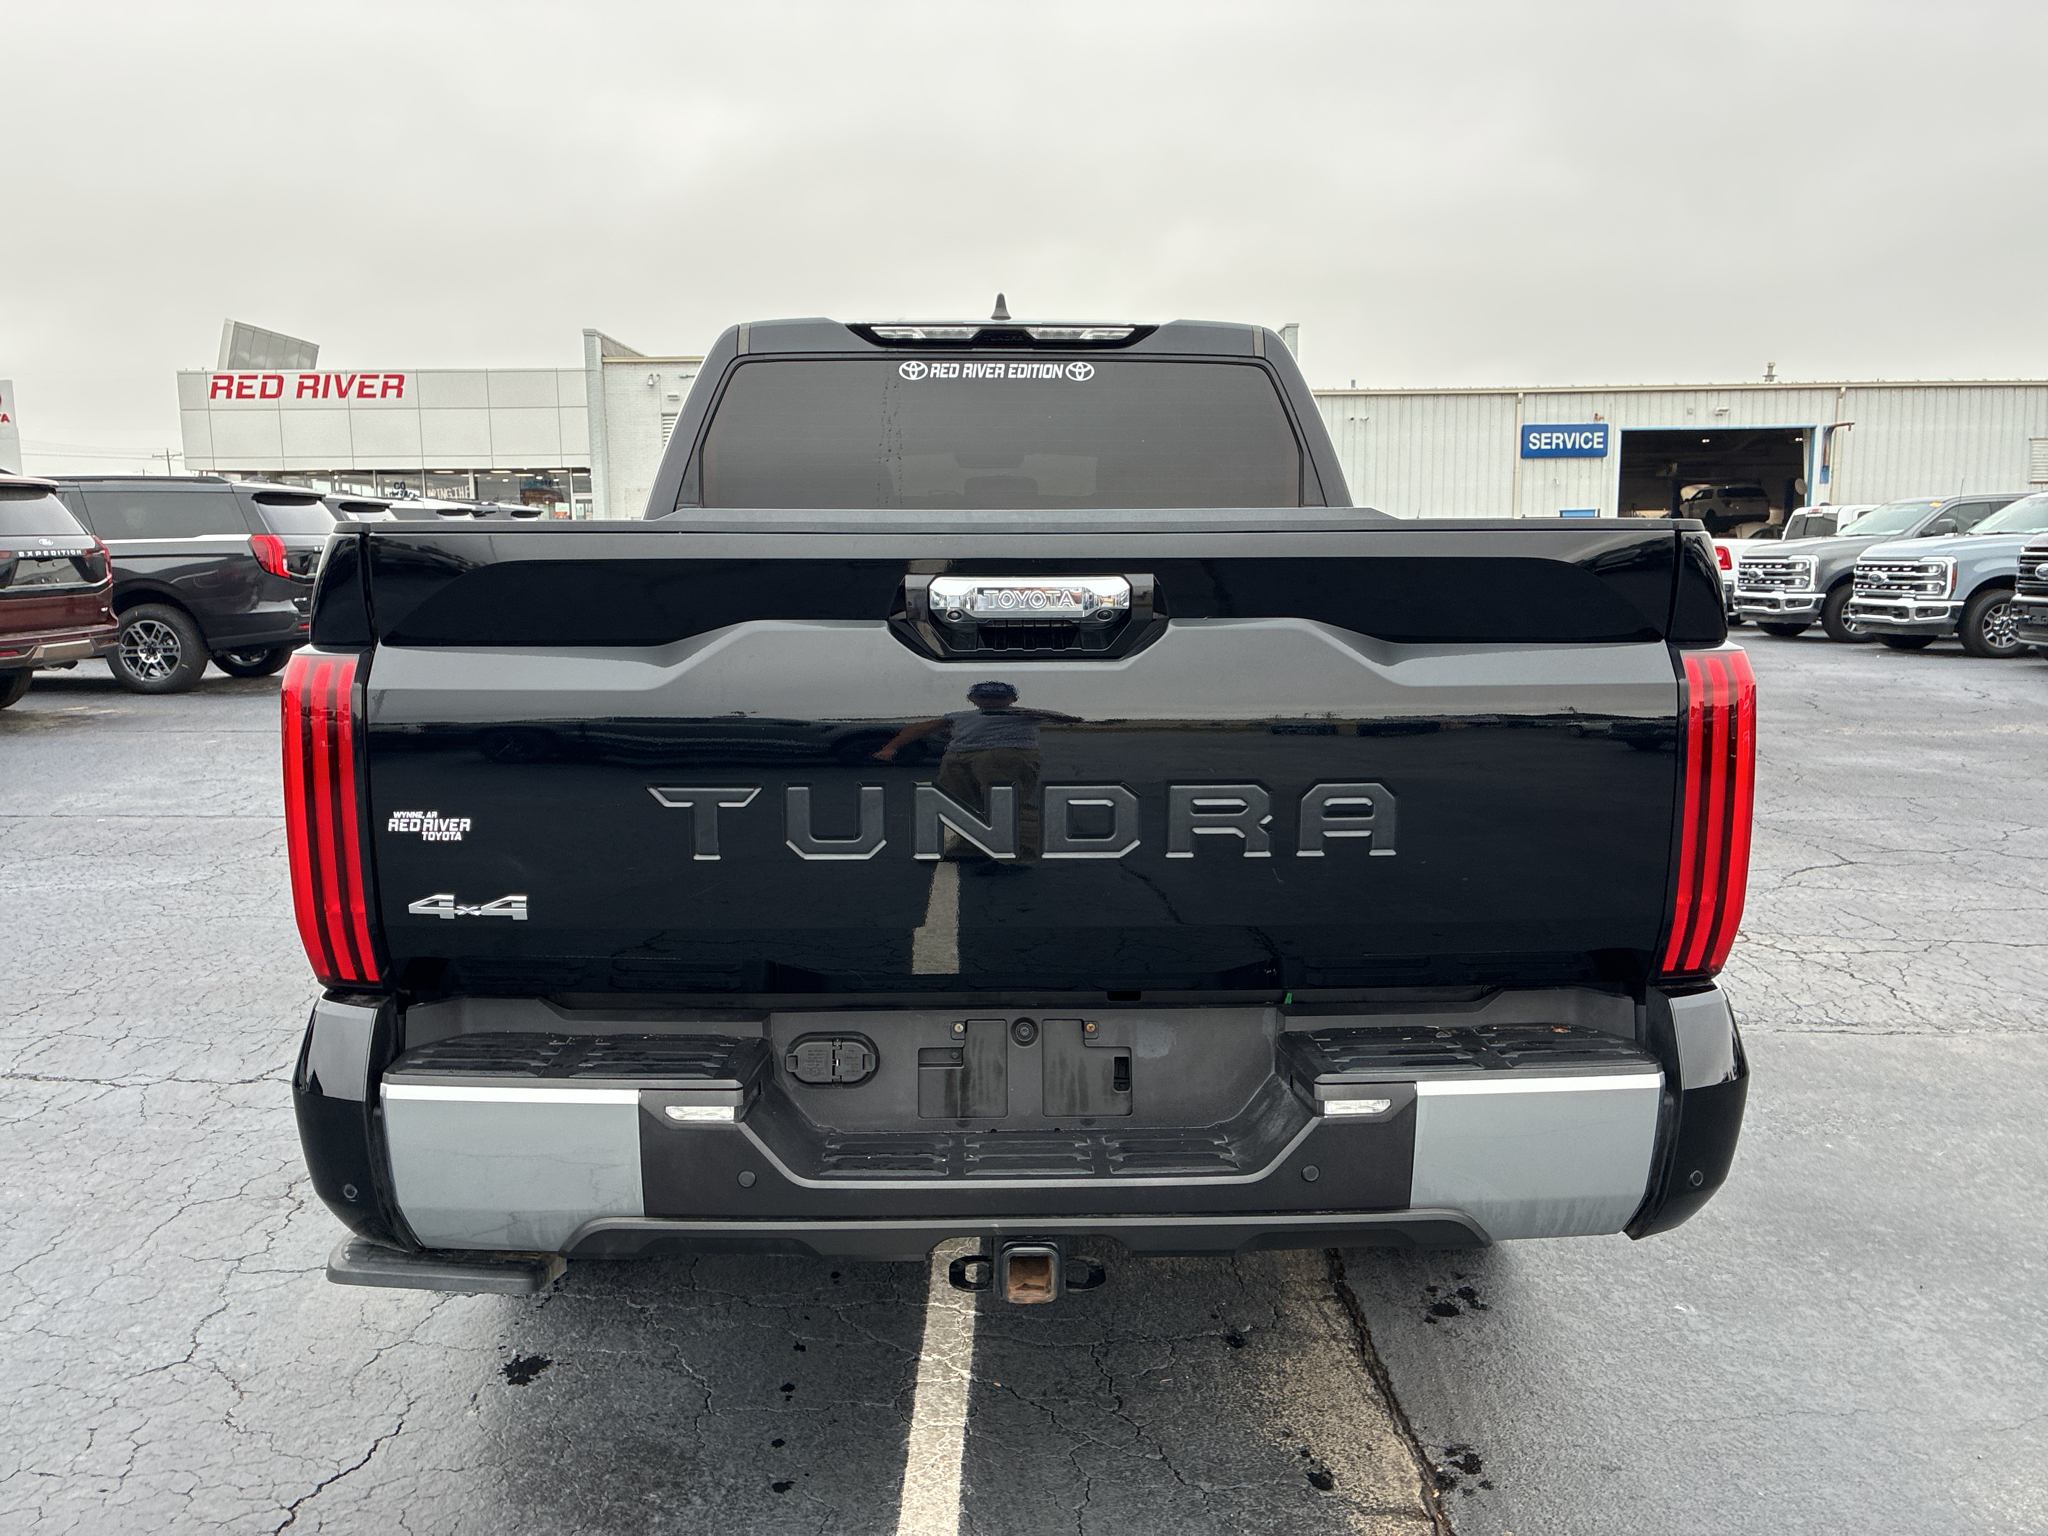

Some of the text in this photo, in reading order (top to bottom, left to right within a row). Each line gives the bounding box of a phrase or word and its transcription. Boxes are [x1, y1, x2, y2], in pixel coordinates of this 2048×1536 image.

[930, 364, 1063, 379] RED RIVER EDITION
[210, 374, 405, 399] RED RIVER
[1528, 432, 1604, 450] SERVICE
[983, 589, 1075, 609] TOYOTA
[426, 811, 438, 819] AR
[646, 782, 1398, 861] TUNDRA
[388, 819, 471, 832] RED RIVER
[422, 832, 462, 841] TOYOTA
[408, 894, 528, 921] 4x4
